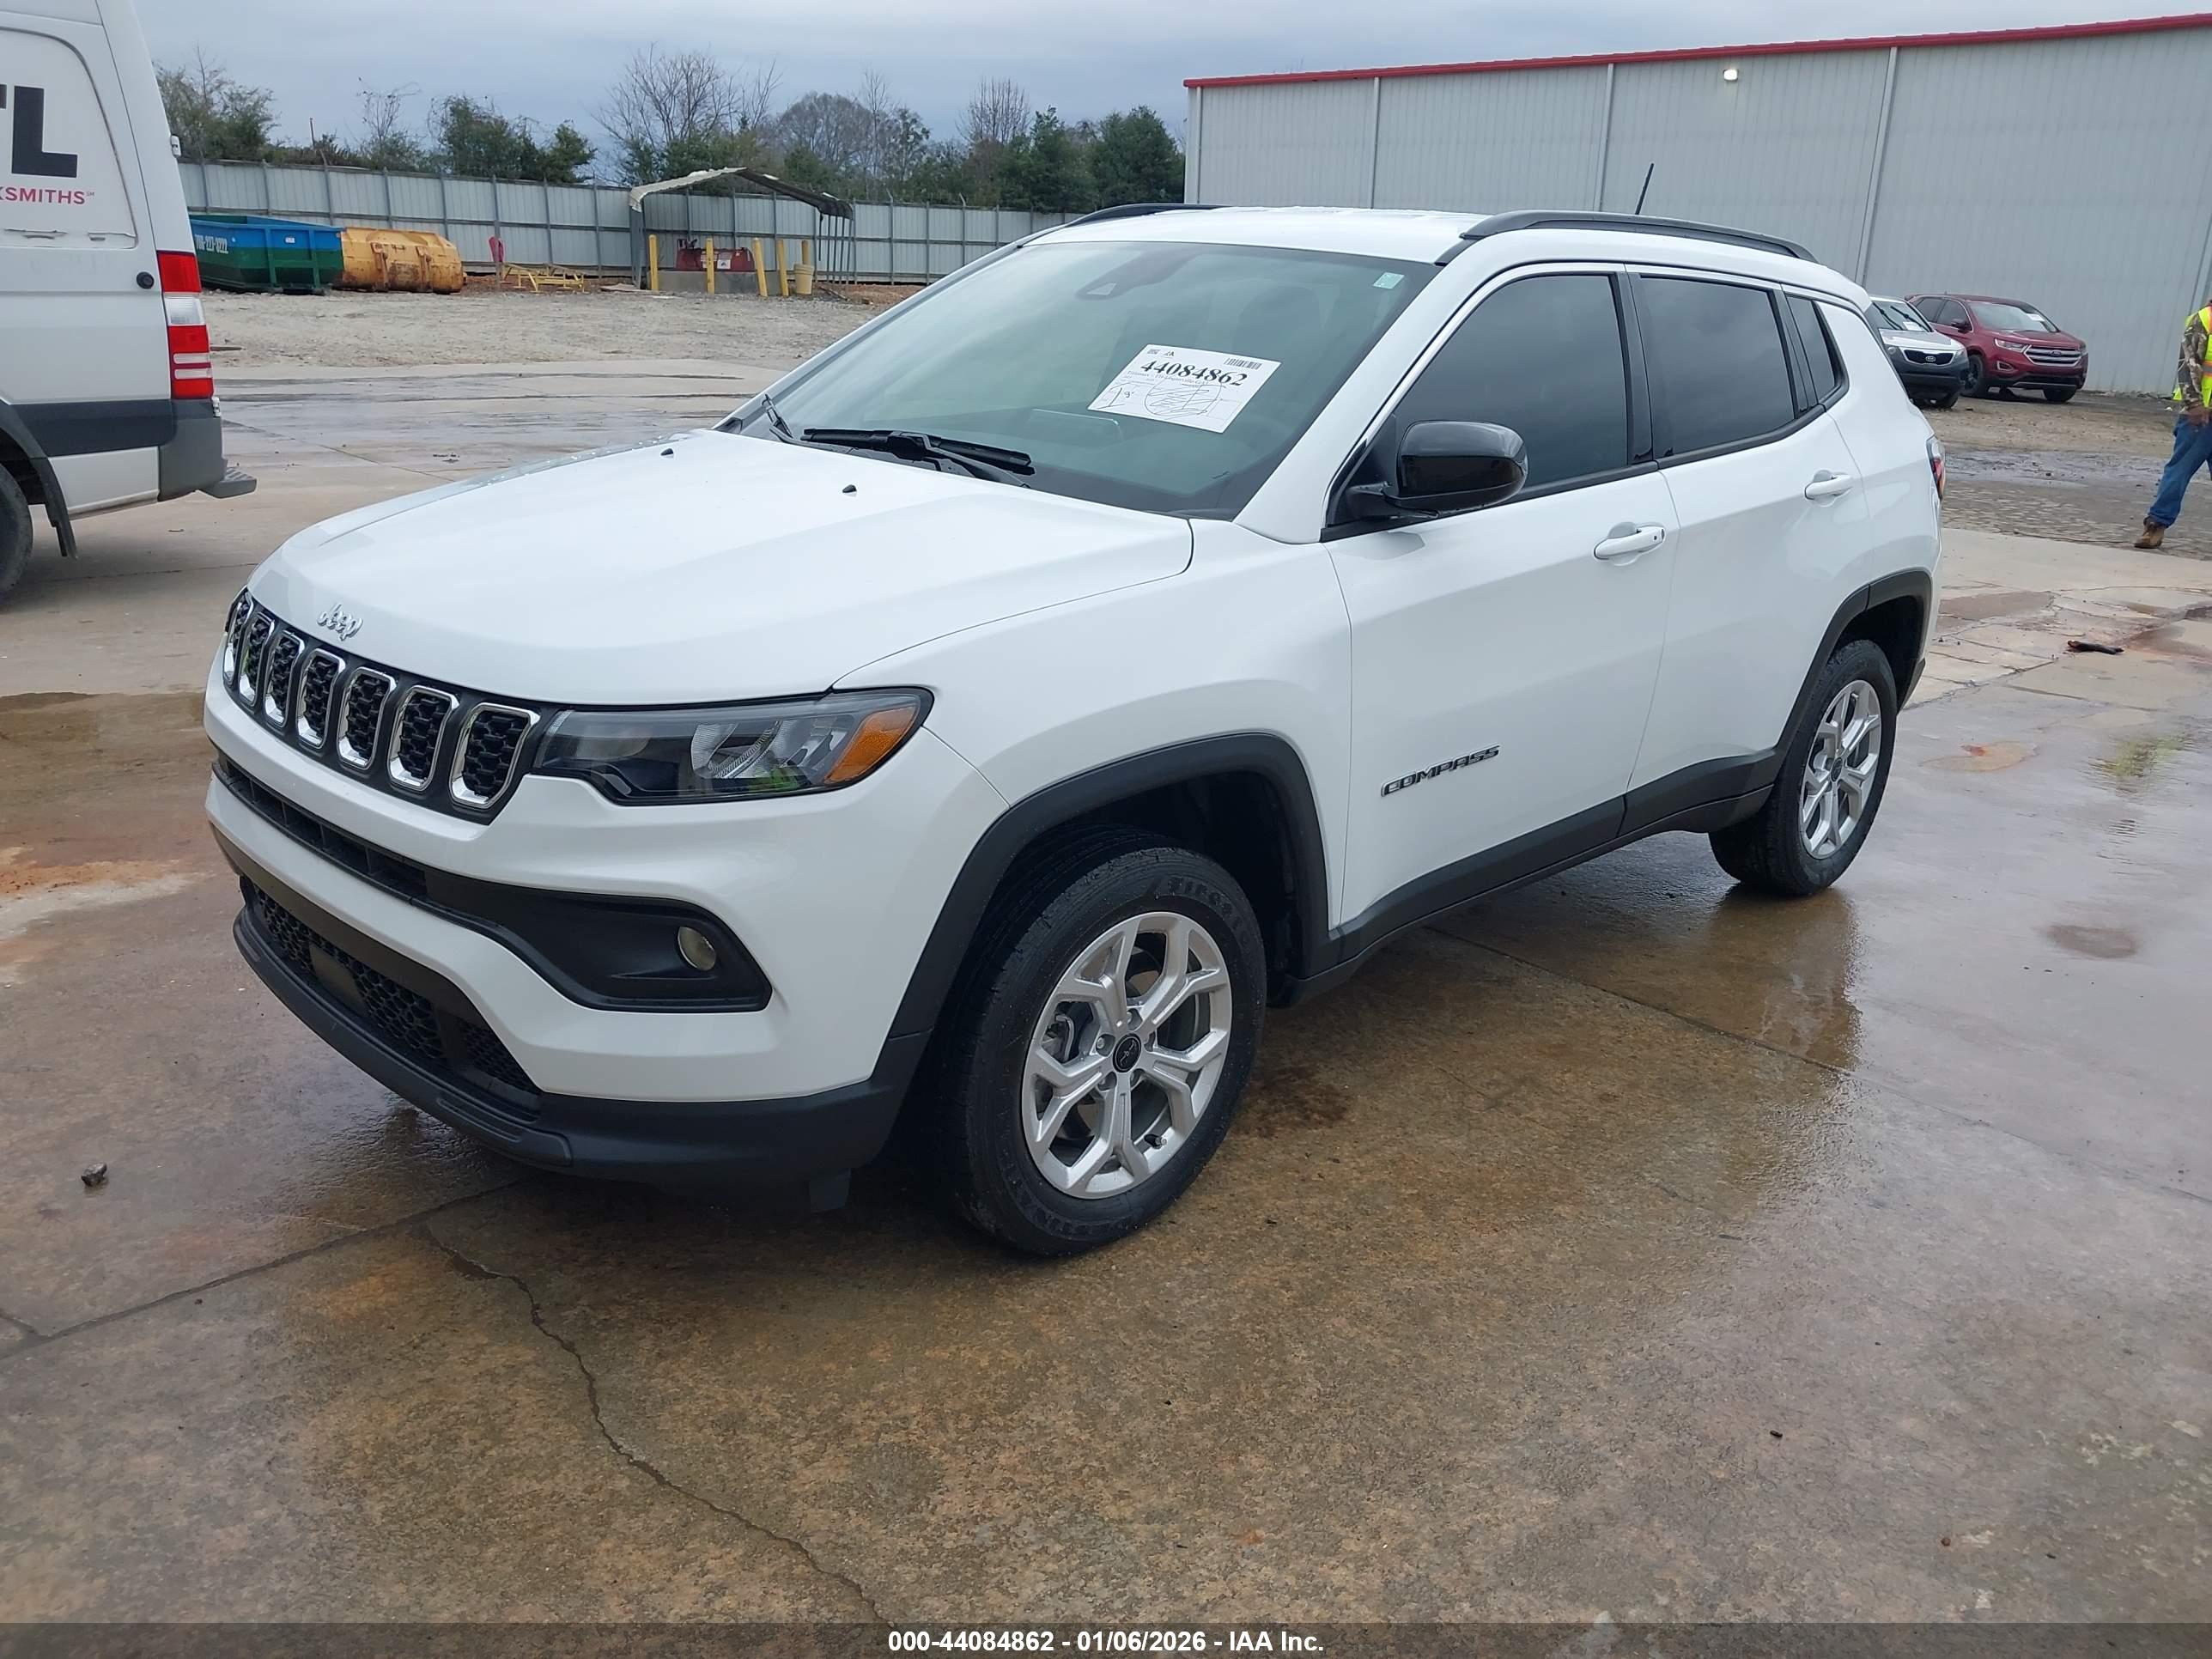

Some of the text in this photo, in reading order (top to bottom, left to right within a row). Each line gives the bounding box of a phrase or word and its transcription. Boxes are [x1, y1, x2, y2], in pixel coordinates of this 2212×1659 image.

[1140, 360, 1248, 386] 44084862
[317, 603, 363, 641] Jeep
[1381, 742, 1501, 797] COMPASS
